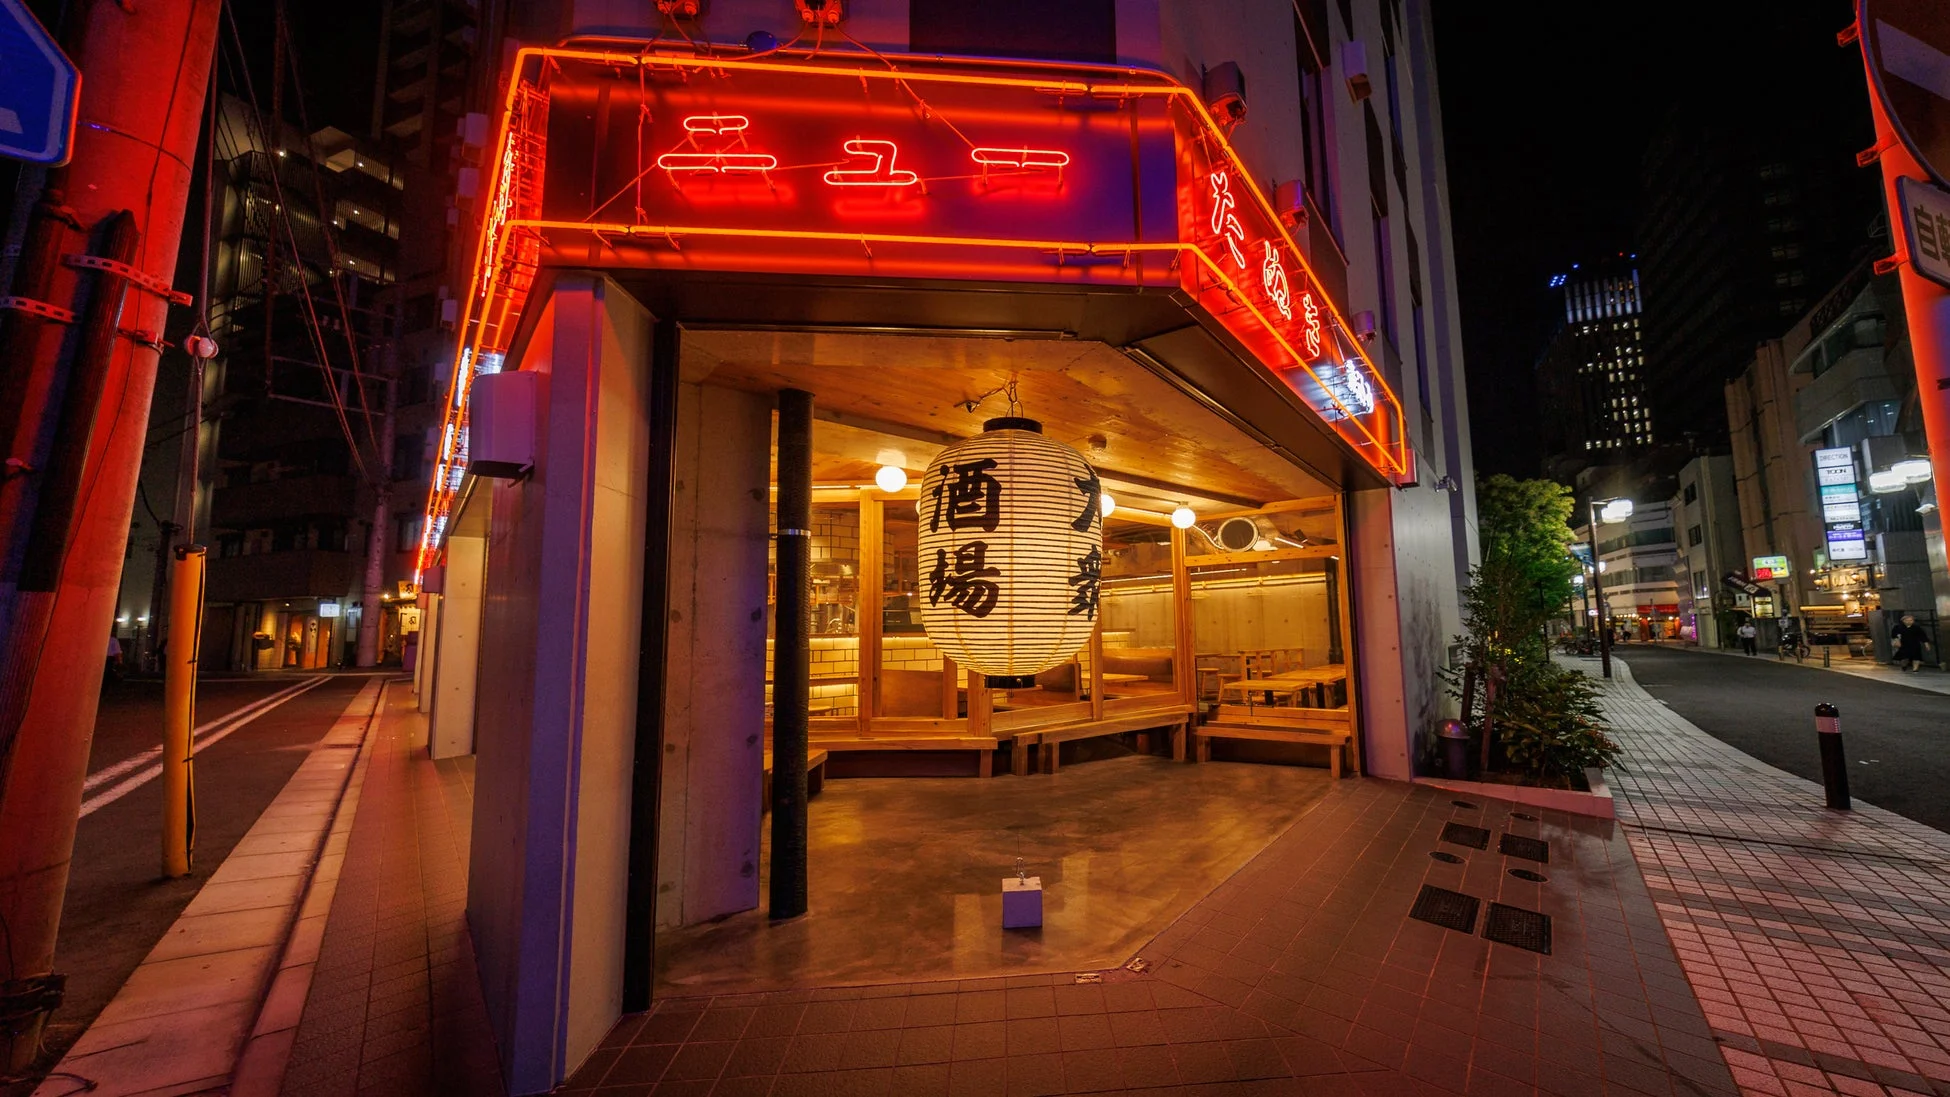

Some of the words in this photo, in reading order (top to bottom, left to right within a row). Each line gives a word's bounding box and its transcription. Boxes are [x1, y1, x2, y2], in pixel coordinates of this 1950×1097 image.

[657, 115, 1070, 187] ニュー
[929, 458, 1002, 619] 酒場
